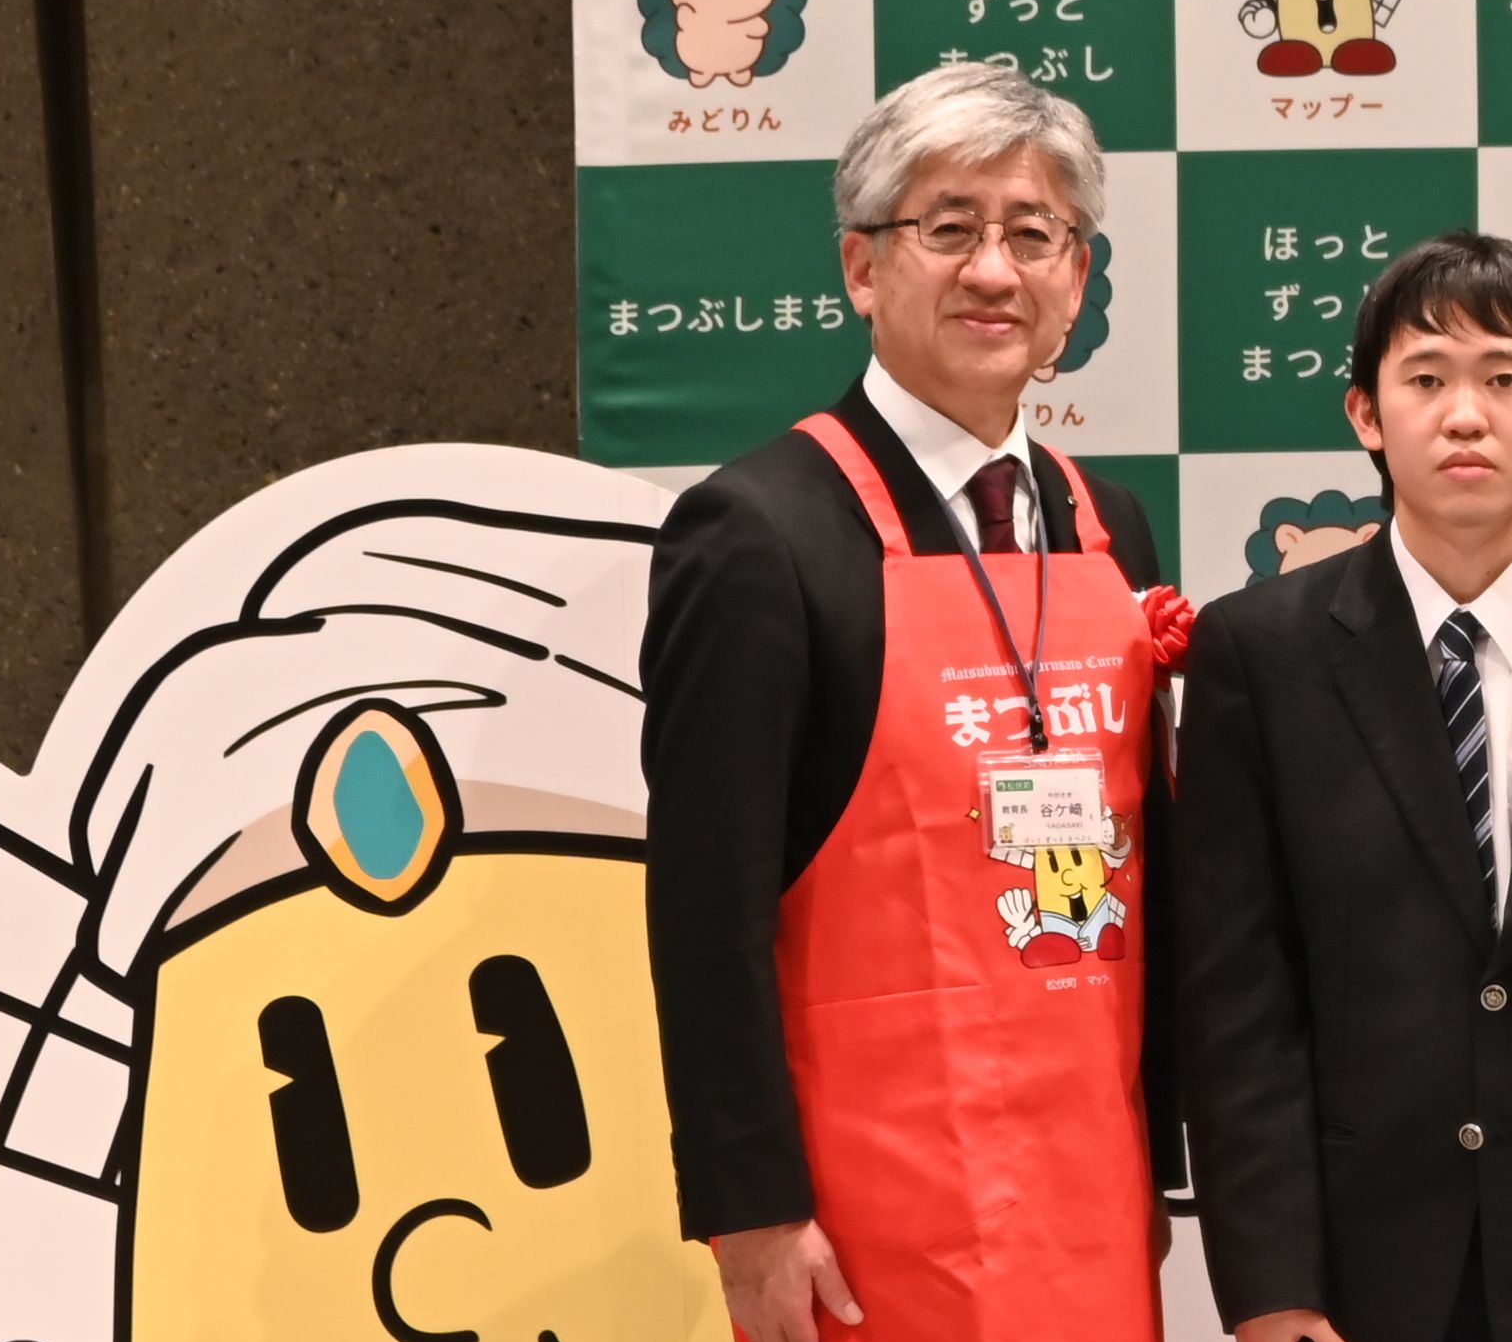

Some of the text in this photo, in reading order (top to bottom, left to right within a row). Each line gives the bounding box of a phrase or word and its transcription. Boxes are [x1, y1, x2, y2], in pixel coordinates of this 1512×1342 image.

[667, 106, 783, 134] みどりん
[1270, 92, 1385, 121] マップー
[1263, 224, 1389, 261] ほっと
[607, 293, 845, 337] まつぶしまち
[1264, 283, 1368, 321] ずっ
[944, 681, 1127, 747] まつぶし
